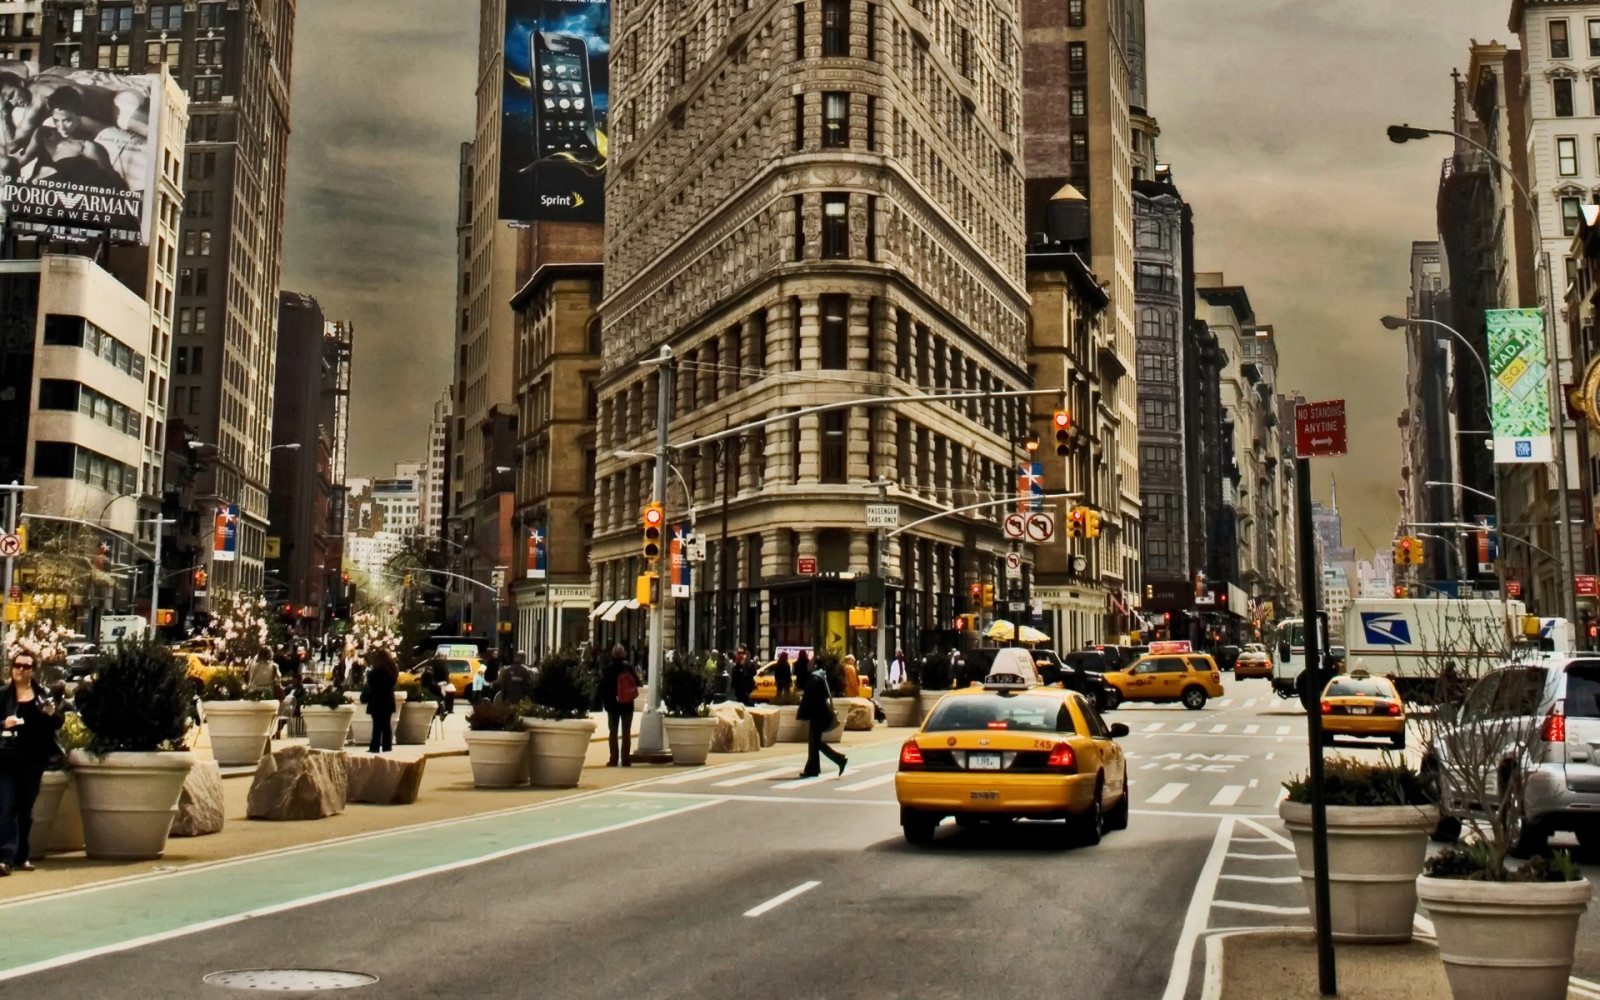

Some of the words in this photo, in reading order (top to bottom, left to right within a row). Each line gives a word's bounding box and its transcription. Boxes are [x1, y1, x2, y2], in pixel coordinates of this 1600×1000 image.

[16, 176, 27, 184] at
[32, 178, 141, 199] emporioarmani.com
[79, 194, 140, 217] ARMANI
[540, 194, 571, 207] Sprint
[11, 203, 112, 223] UNDERWEAR
[1489, 344, 1521, 374] MAD.
[1502, 364, 1526, 385] SQ.
[1297, 409, 1308, 420] NO
[1310, 405, 1343, 419] STANDING
[1304, 420, 1338, 434] ANYTIME
[867, 507, 897, 515] PASSENGER
[1033, 739, 1052, 749] 245
